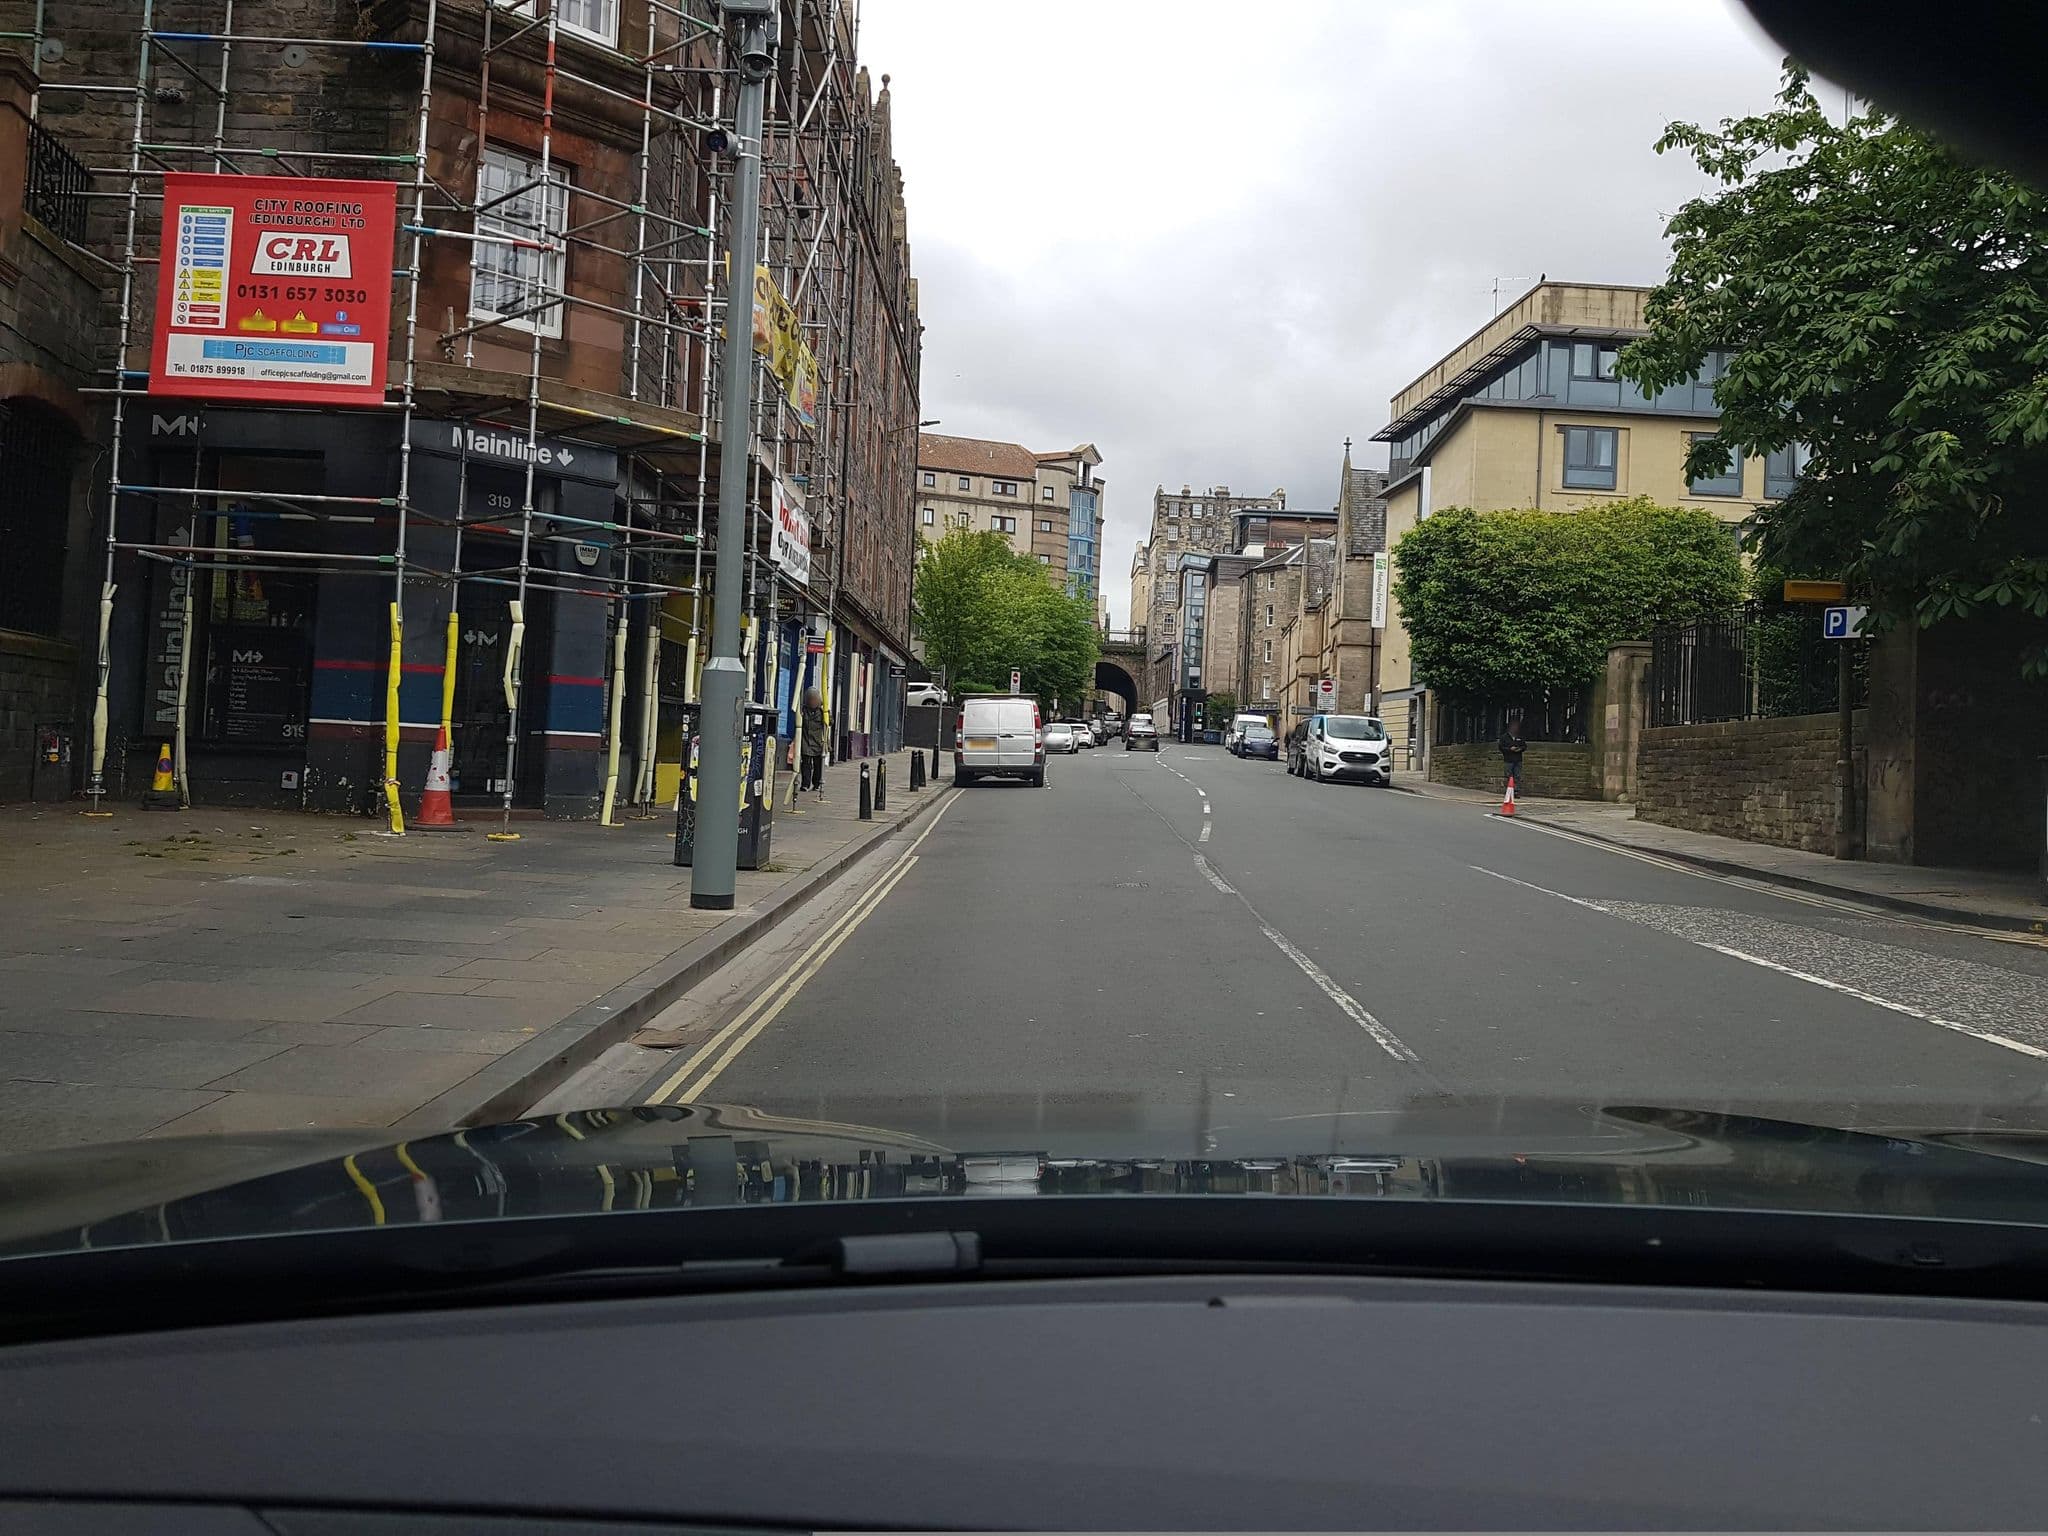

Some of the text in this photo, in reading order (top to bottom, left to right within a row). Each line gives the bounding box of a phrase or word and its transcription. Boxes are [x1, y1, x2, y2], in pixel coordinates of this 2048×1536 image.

[254, 199, 363, 215] CITY ROOFING
[250, 214, 366, 228] (EDINBURGH) LTD
[266, 238, 340, 262] CRL
[270, 261, 331, 273] EDINBURGH
[237, 284, 367, 303] 0131 657 3030
[257, 347, 319, 359] SCAFFOLDING
[174, 363, 246, 375] Tel. 01875 899918
[260, 368, 367, 381] officepjcscaffolding@gmail.com
[487, 493, 512, 509] 319
[1828, 612, 1842, 634] P
